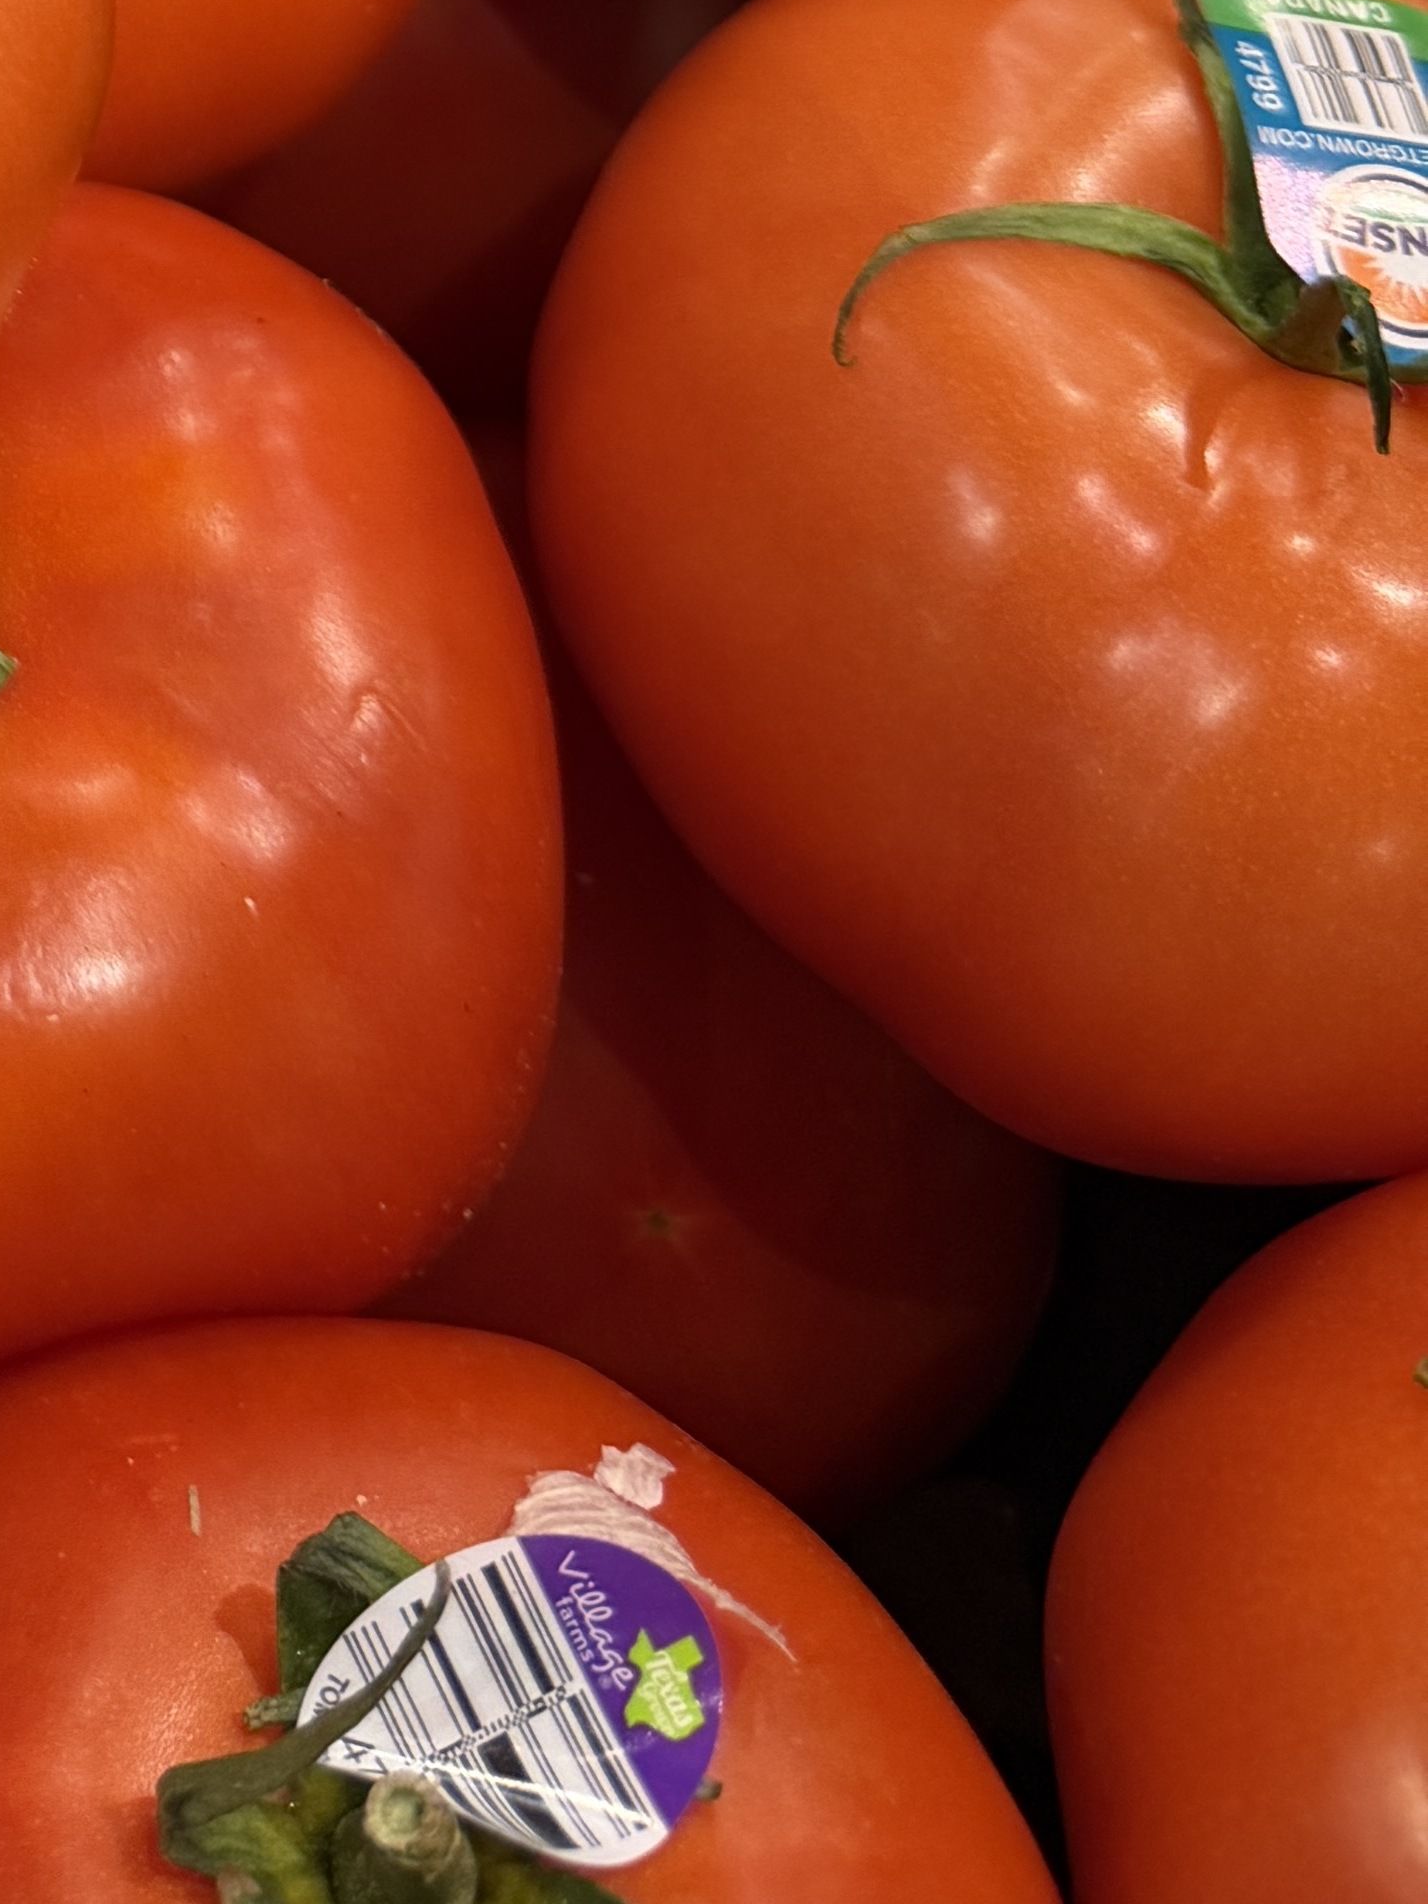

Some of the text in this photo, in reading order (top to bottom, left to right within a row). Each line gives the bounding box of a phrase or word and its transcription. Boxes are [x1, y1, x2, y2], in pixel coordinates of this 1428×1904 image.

[1235, 41, 1283, 110] 4799
[1257, 125, 1428, 166] ETGROWN.COM
[1338, 214, 1428, 257] NSE
[556, 1594, 594, 1662] farms
[558, 1550, 634, 1690] Village
